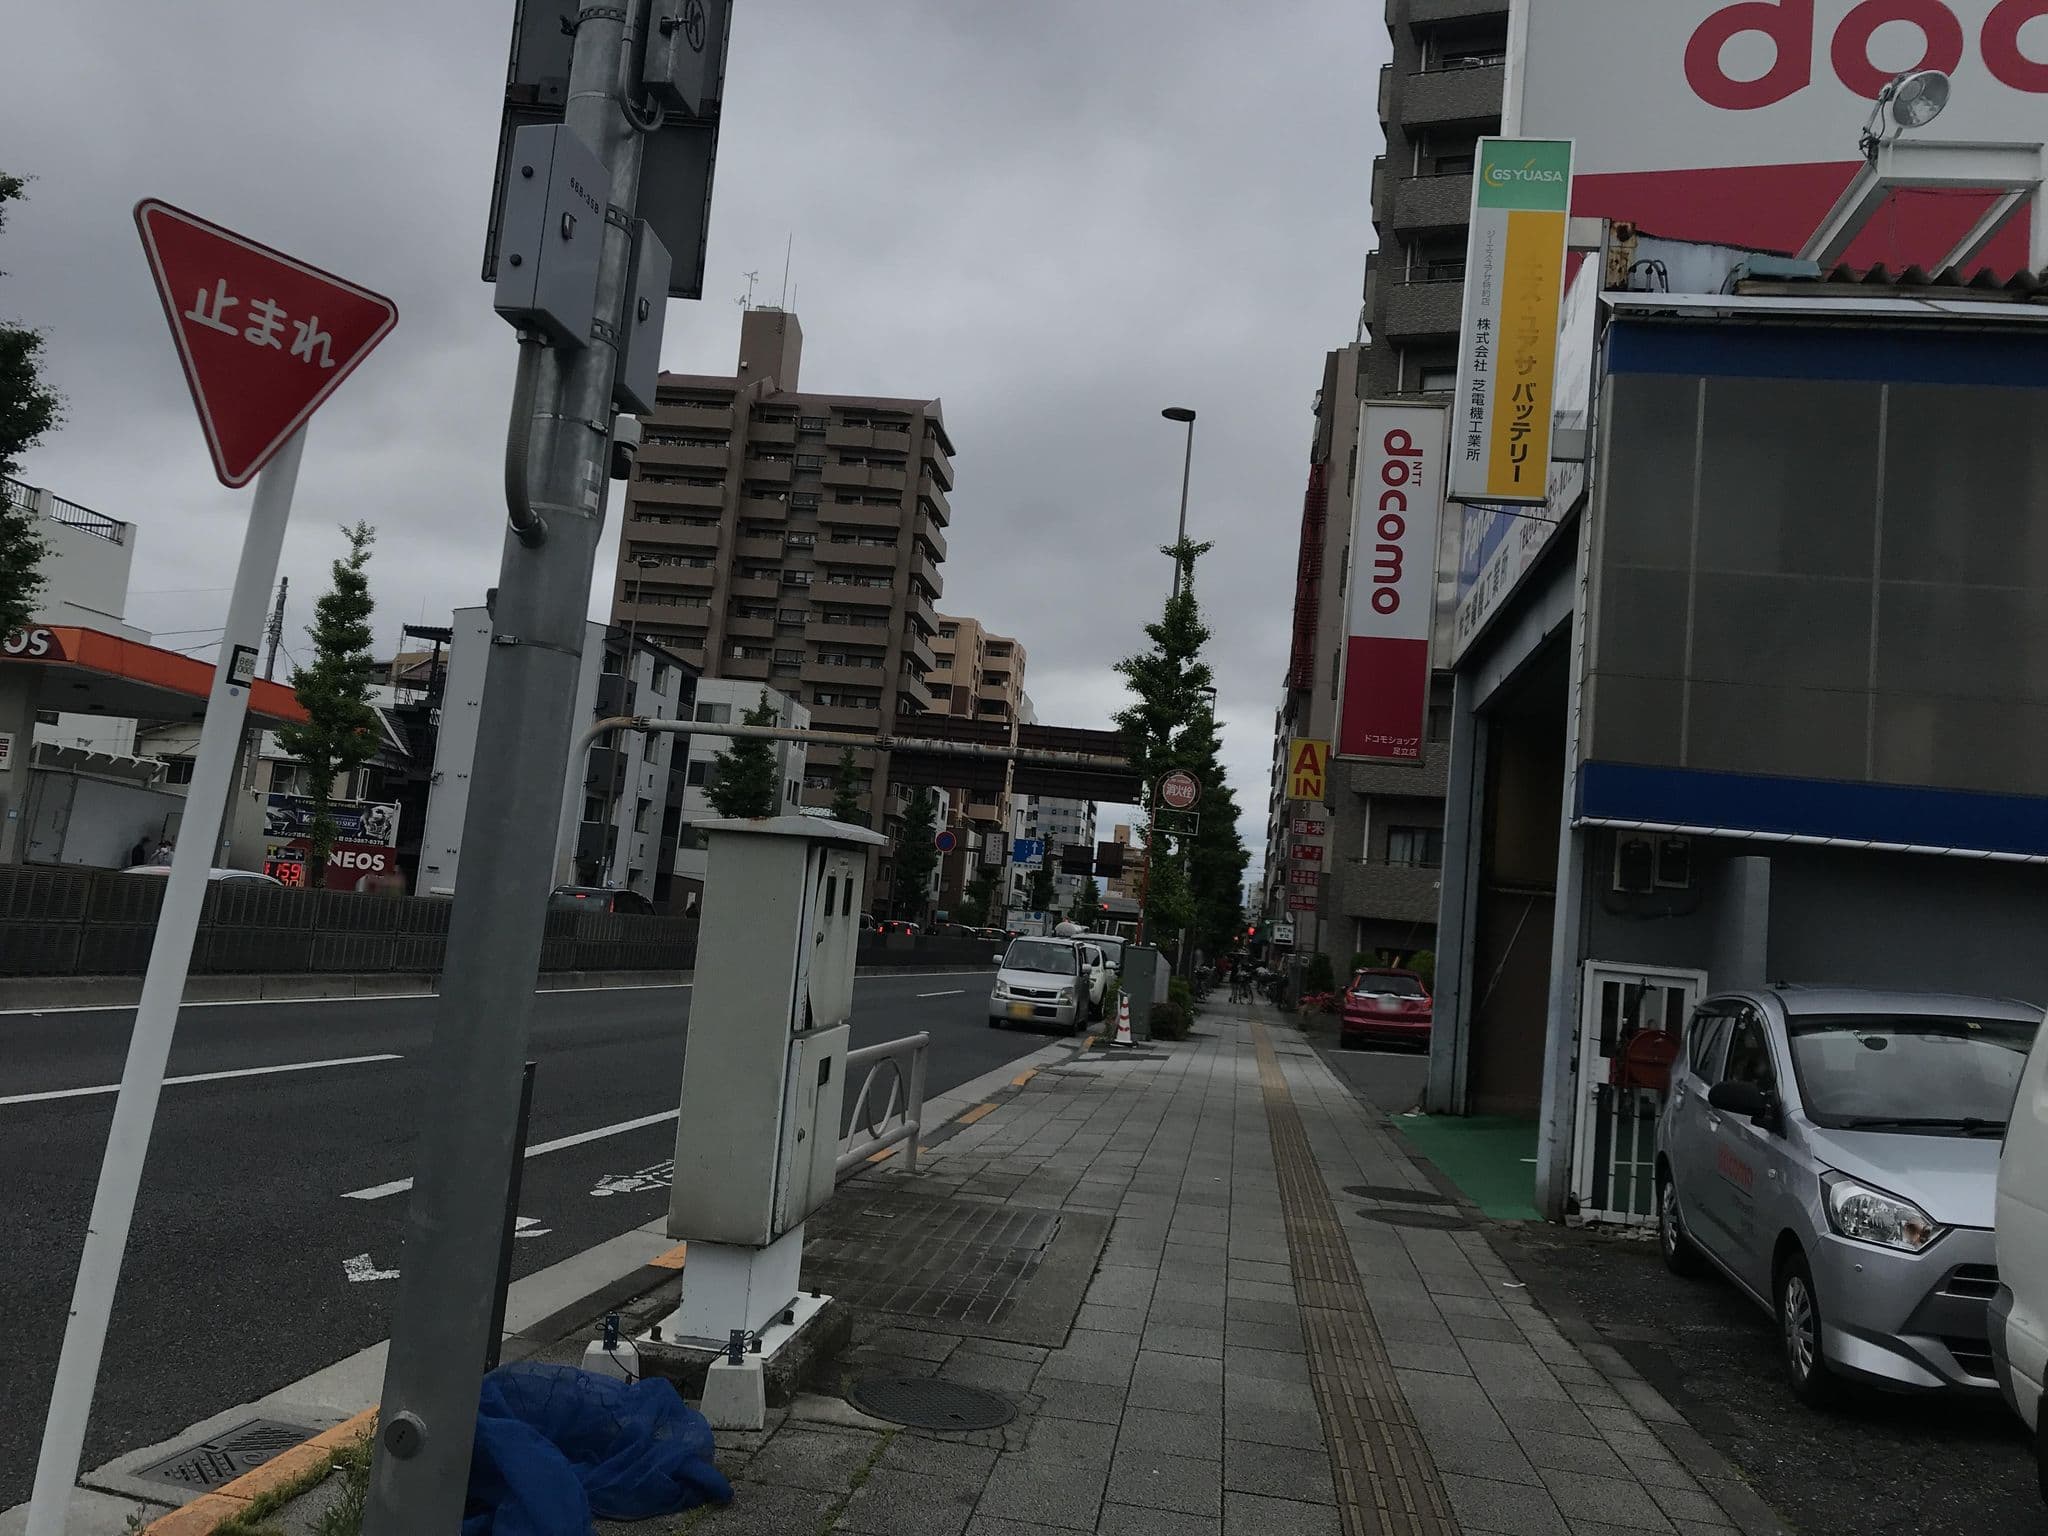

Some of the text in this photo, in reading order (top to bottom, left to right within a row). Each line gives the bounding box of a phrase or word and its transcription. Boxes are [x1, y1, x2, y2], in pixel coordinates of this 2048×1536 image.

[1492, 168, 1563, 183] GS YUASA
[184, 278, 336, 368] 止まれ
[1465, 317, 1492, 462] 株式会社 芝電機工業所
[1510, 382, 1538, 483] バッテリー
[1412, 461, 1424, 487] NTT
[1371, 428, 1424, 615] docomo
[1364, 733, 1419, 746] ドコモショップ
[1293, 743, 1322, 776] A
[1392, 746, 1418, 758] 足立店
[1165, 783, 1193, 799] 消火栓
[1295, 777, 1321, 797] IN
[327, 850, 386, 872] NEOS
